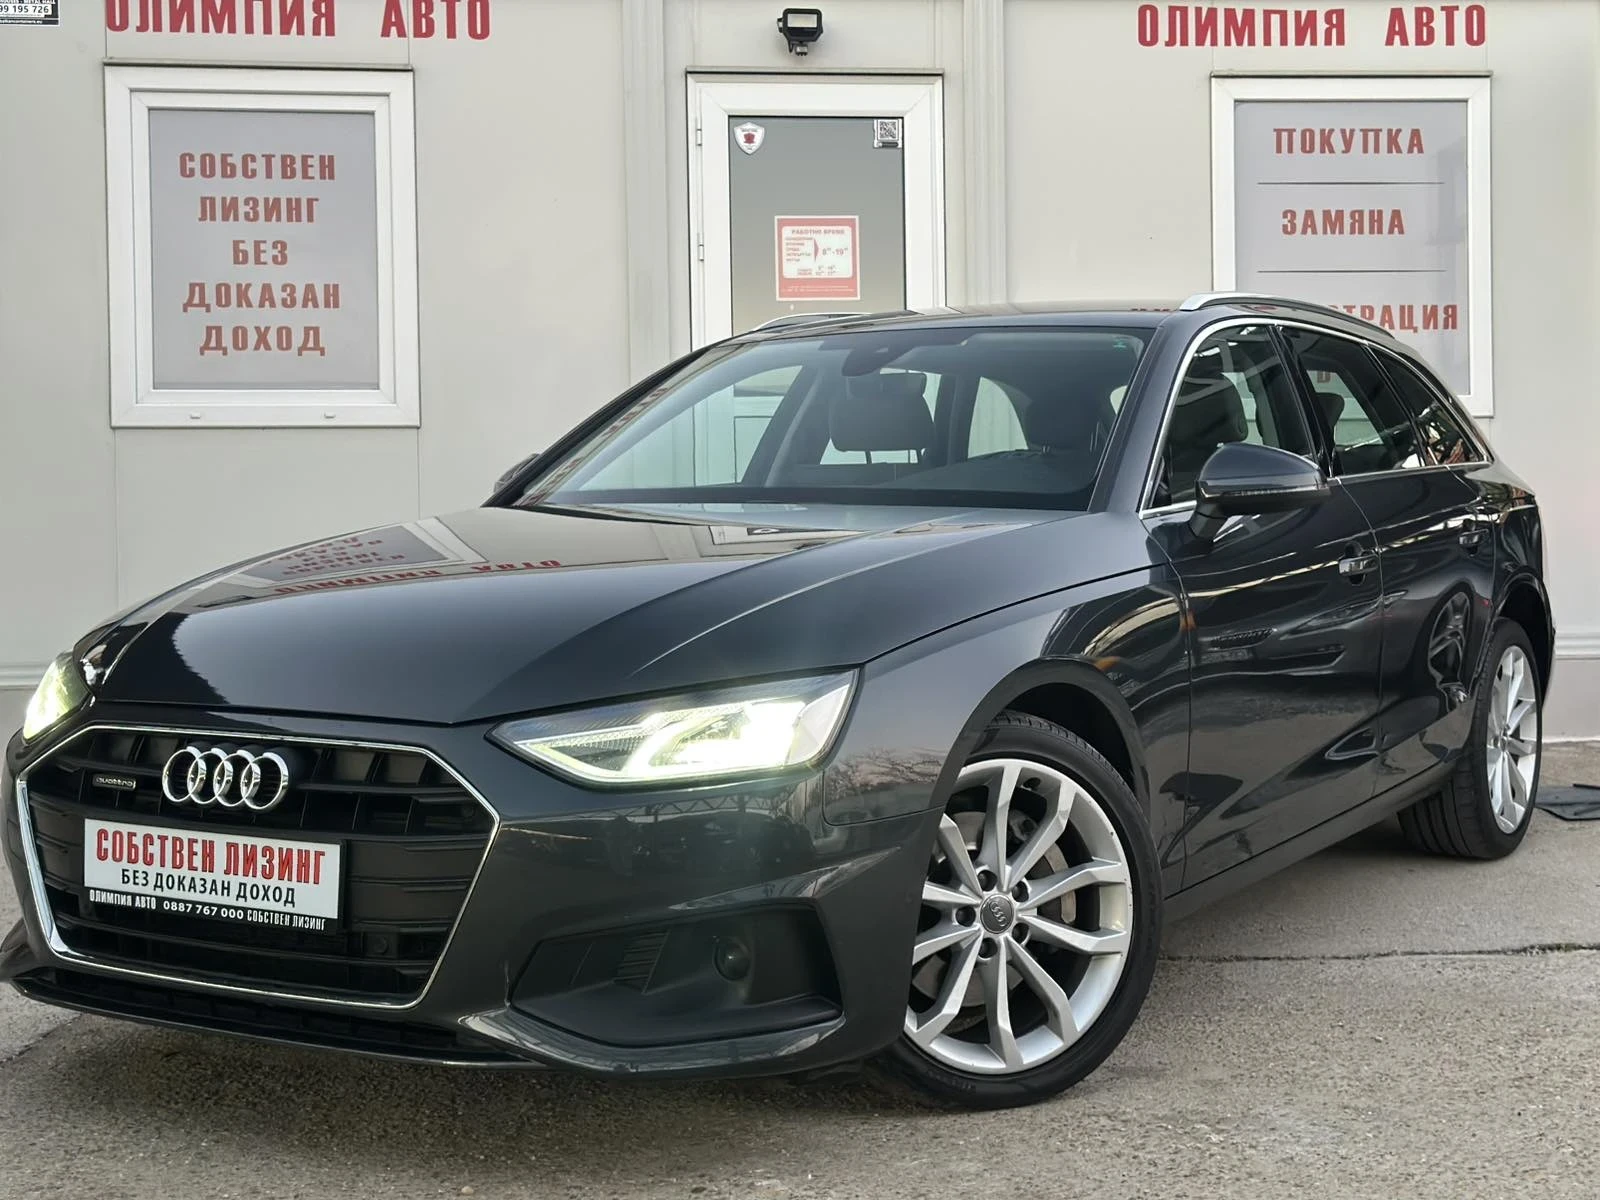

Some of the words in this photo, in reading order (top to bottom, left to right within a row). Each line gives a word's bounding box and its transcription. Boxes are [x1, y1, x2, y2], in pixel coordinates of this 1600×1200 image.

[13, 5, 29, 13] 195
[32, 5, 49, 14] 726
[106, 0, 335, 36] ОЛИМПИЯ
[381, 0, 490, 40] АВТО
[1138, 4, 1345, 47] ОЛИМПИЯ
[1385, 4, 1485, 47] АВТО
[1273, 128, 1424, 154] ПОКУПКА
[179, 152, 335, 180] СОБСТВЕН
[198, 196, 319, 223] ЛИЗИНГ
[1282, 209, 1405, 235] ЗАМЯНА
[232, 240, 288, 265] БЕЗ
[182, 282, 340, 313] ДОКАЗАН
[199, 326, 325, 356] ДОХОД
[97, 828, 215, 873] СОБСТВЕН
[224, 841, 325, 885] ЛИЗИНГ
[122, 869, 149, 887] БЕЗ
[154, 872, 231, 897] ДОКАЗАН
[236, 882, 295, 908] ДОХОД
[90, 889, 132, 906] ОЛИМПИЯ
[135, 895, 156, 910] АВТО
[163, 901, 192, 913] 0887
[196, 904, 217, 916] 767
[221, 908, 244, 919] 000
[247, 909, 290, 926] СОБСТВЕН
[292, 915, 326, 931] ЛИЗИНГ
